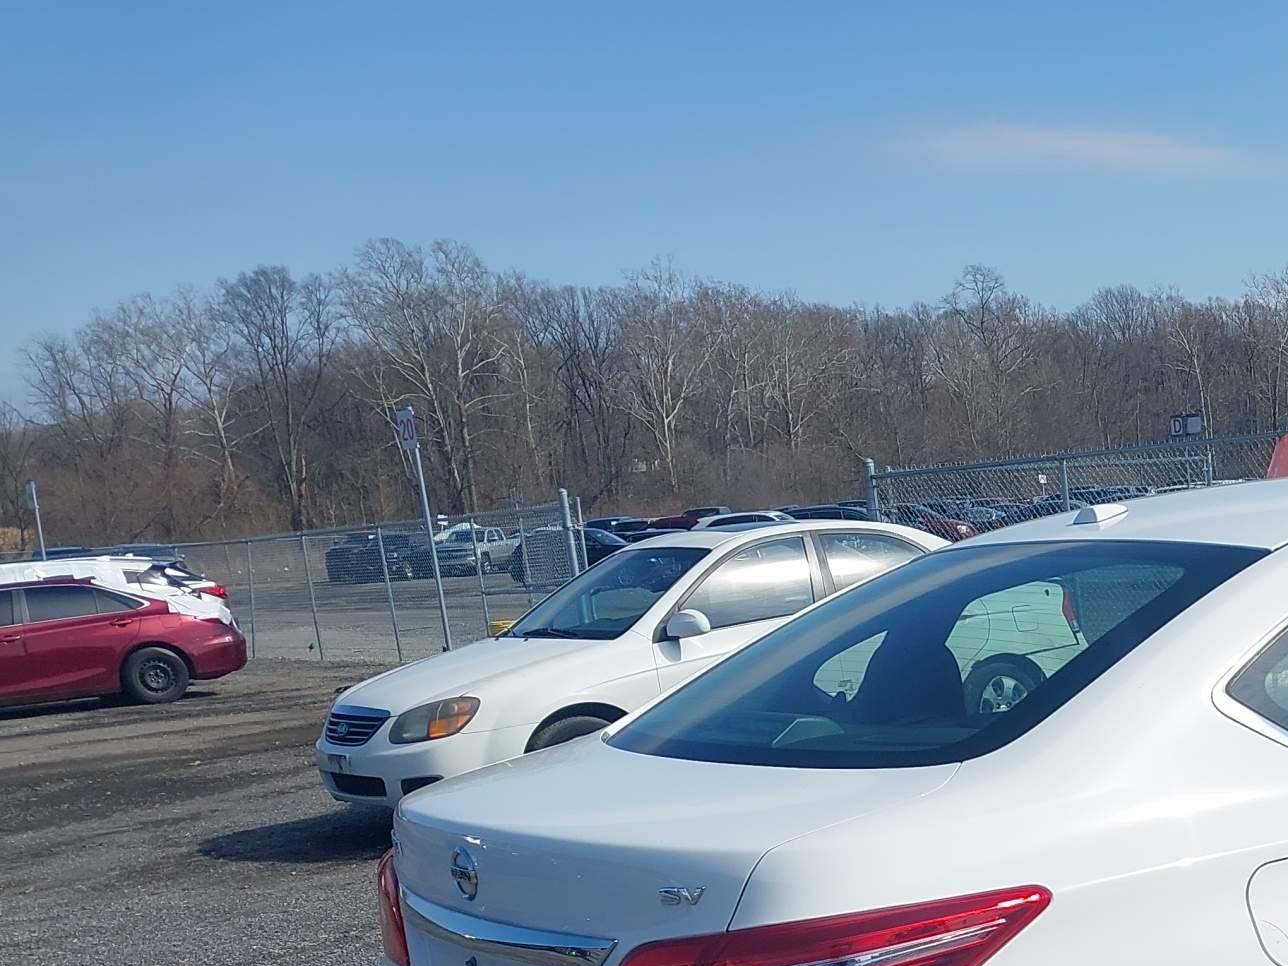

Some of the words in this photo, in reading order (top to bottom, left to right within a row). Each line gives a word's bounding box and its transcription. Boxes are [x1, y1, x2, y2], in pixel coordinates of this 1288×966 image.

[399, 418, 414, 441] 20
[1173, 419, 1182, 433] D
[657, 886, 706, 906] SV
